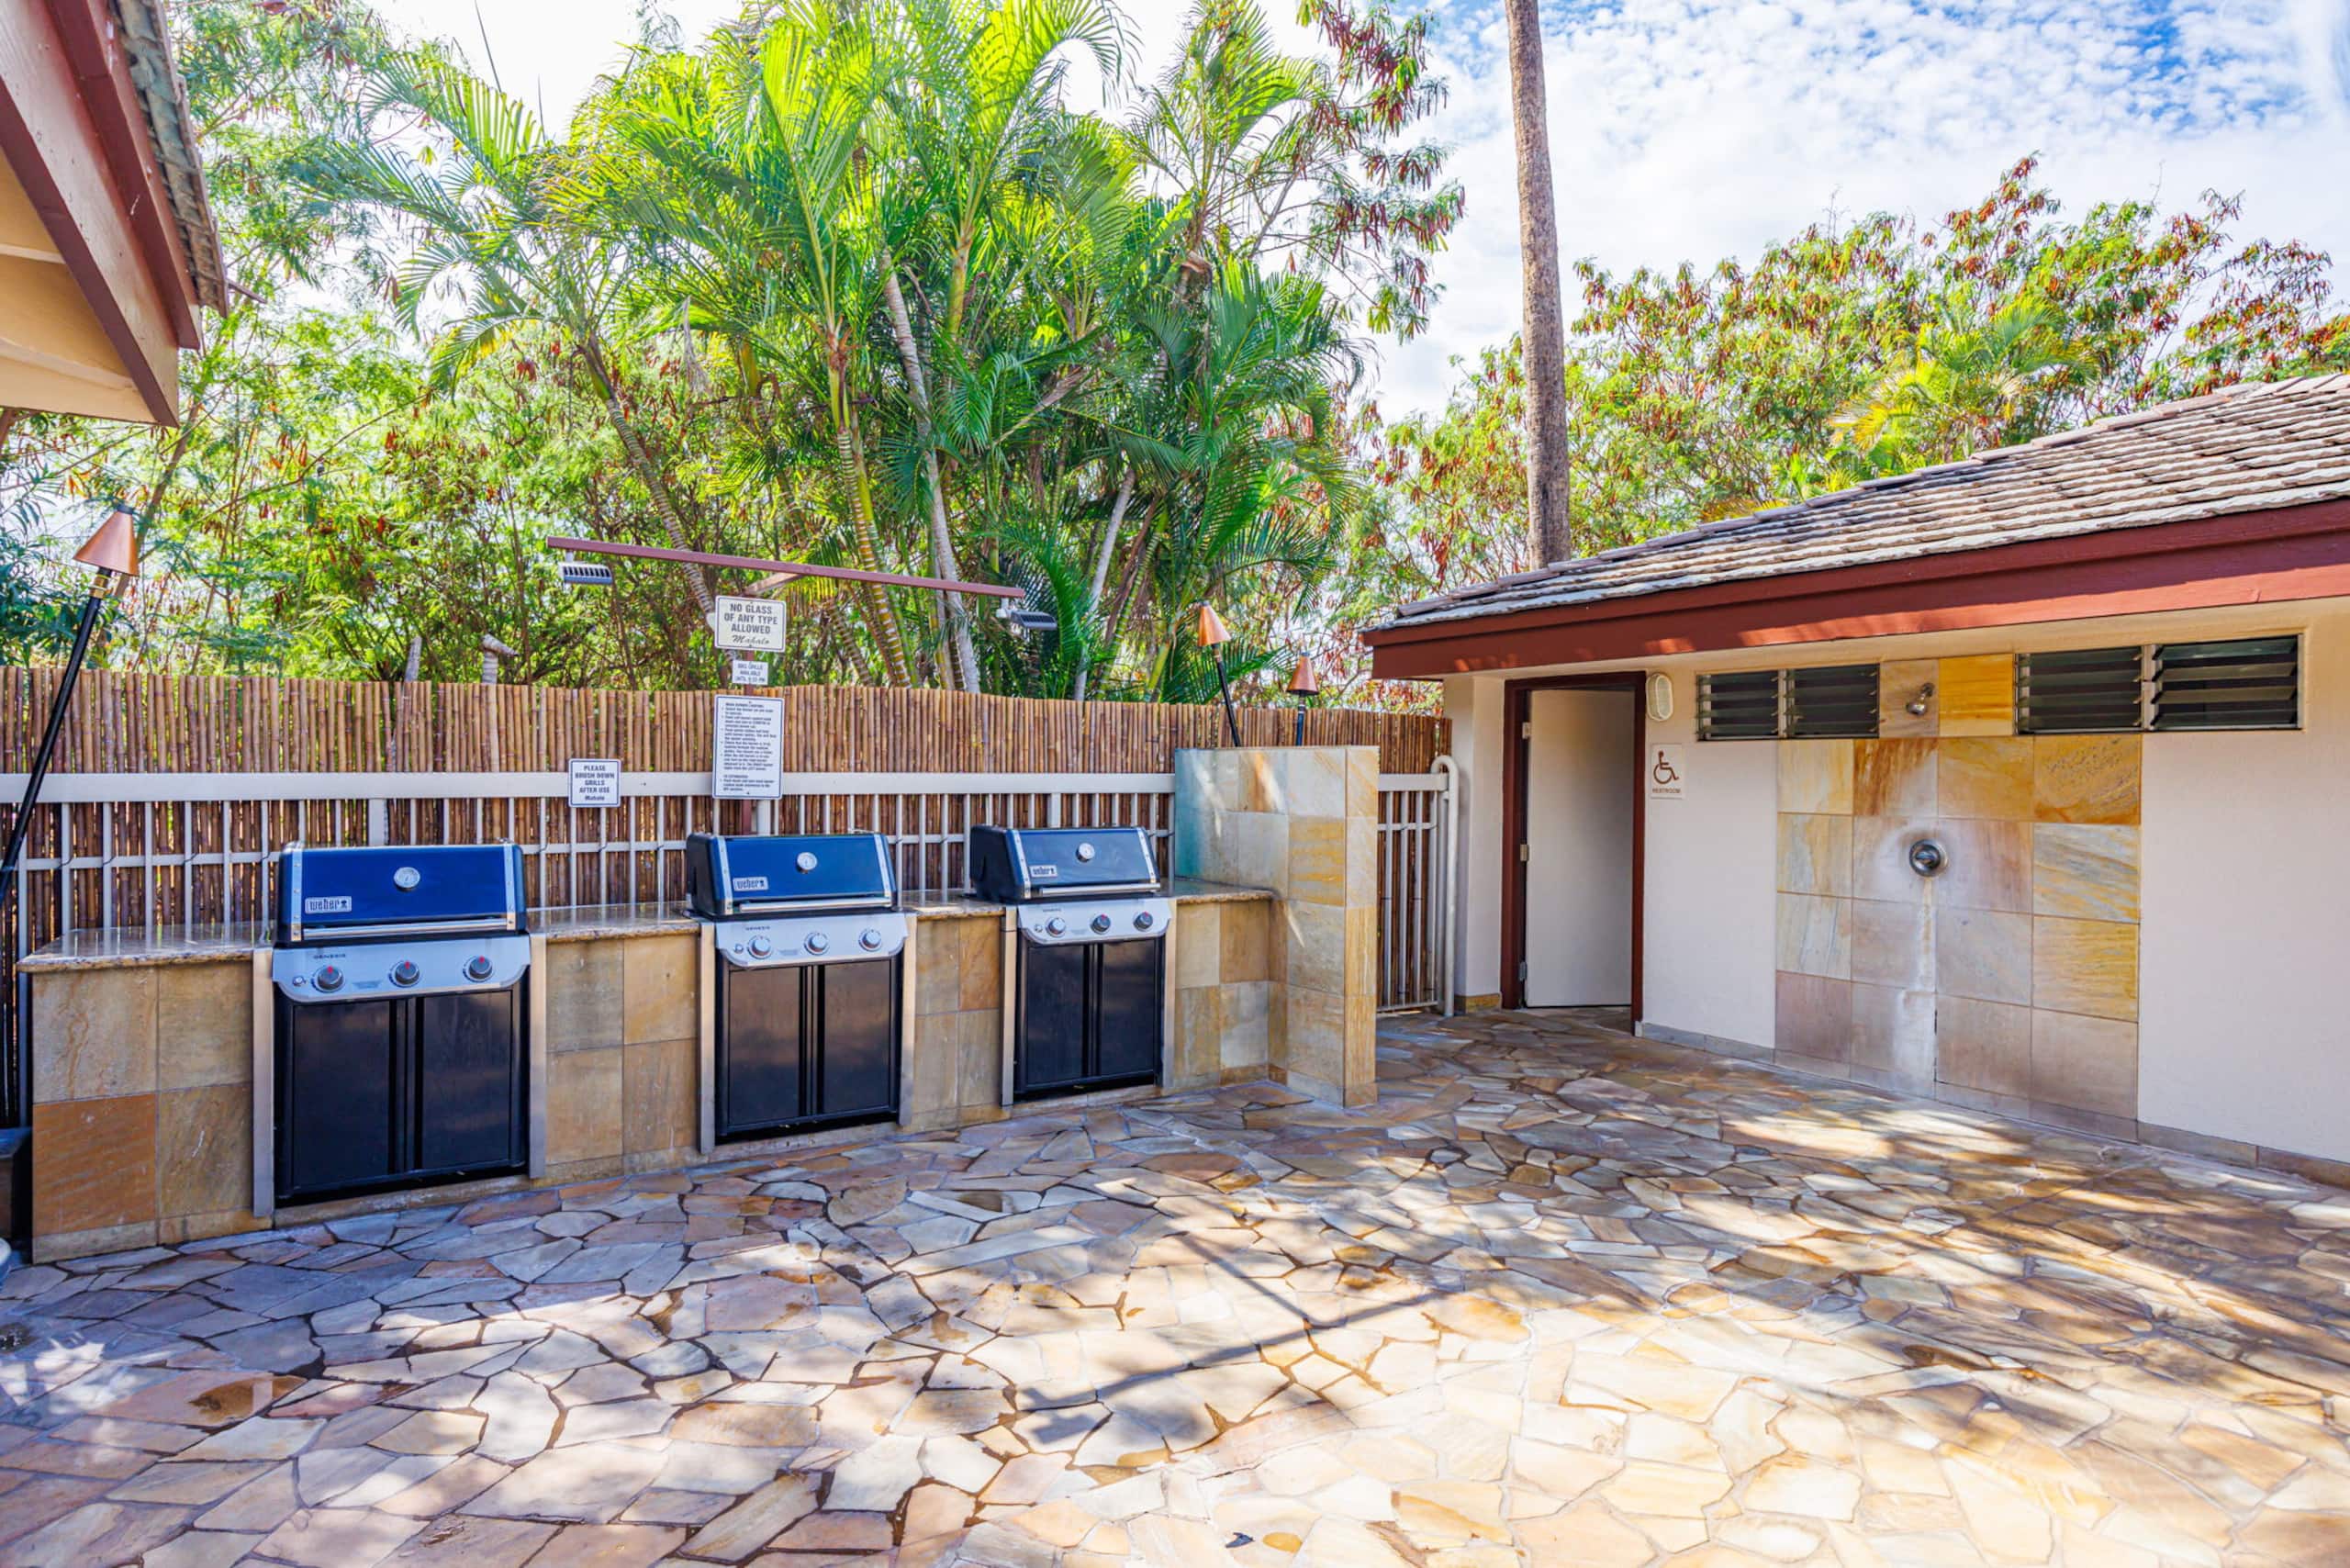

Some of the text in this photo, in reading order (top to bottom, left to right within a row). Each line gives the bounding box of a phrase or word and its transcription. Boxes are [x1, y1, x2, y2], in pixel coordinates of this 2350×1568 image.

[730, 603, 772, 614] NO GLASS
[724, 613, 778, 624] OF ANY TYPE
[731, 623, 771, 633] ALLOWED
[733, 634, 769, 645] Mahalo
[736, 879, 759, 890] weber
[309, 898, 340, 911] weber
